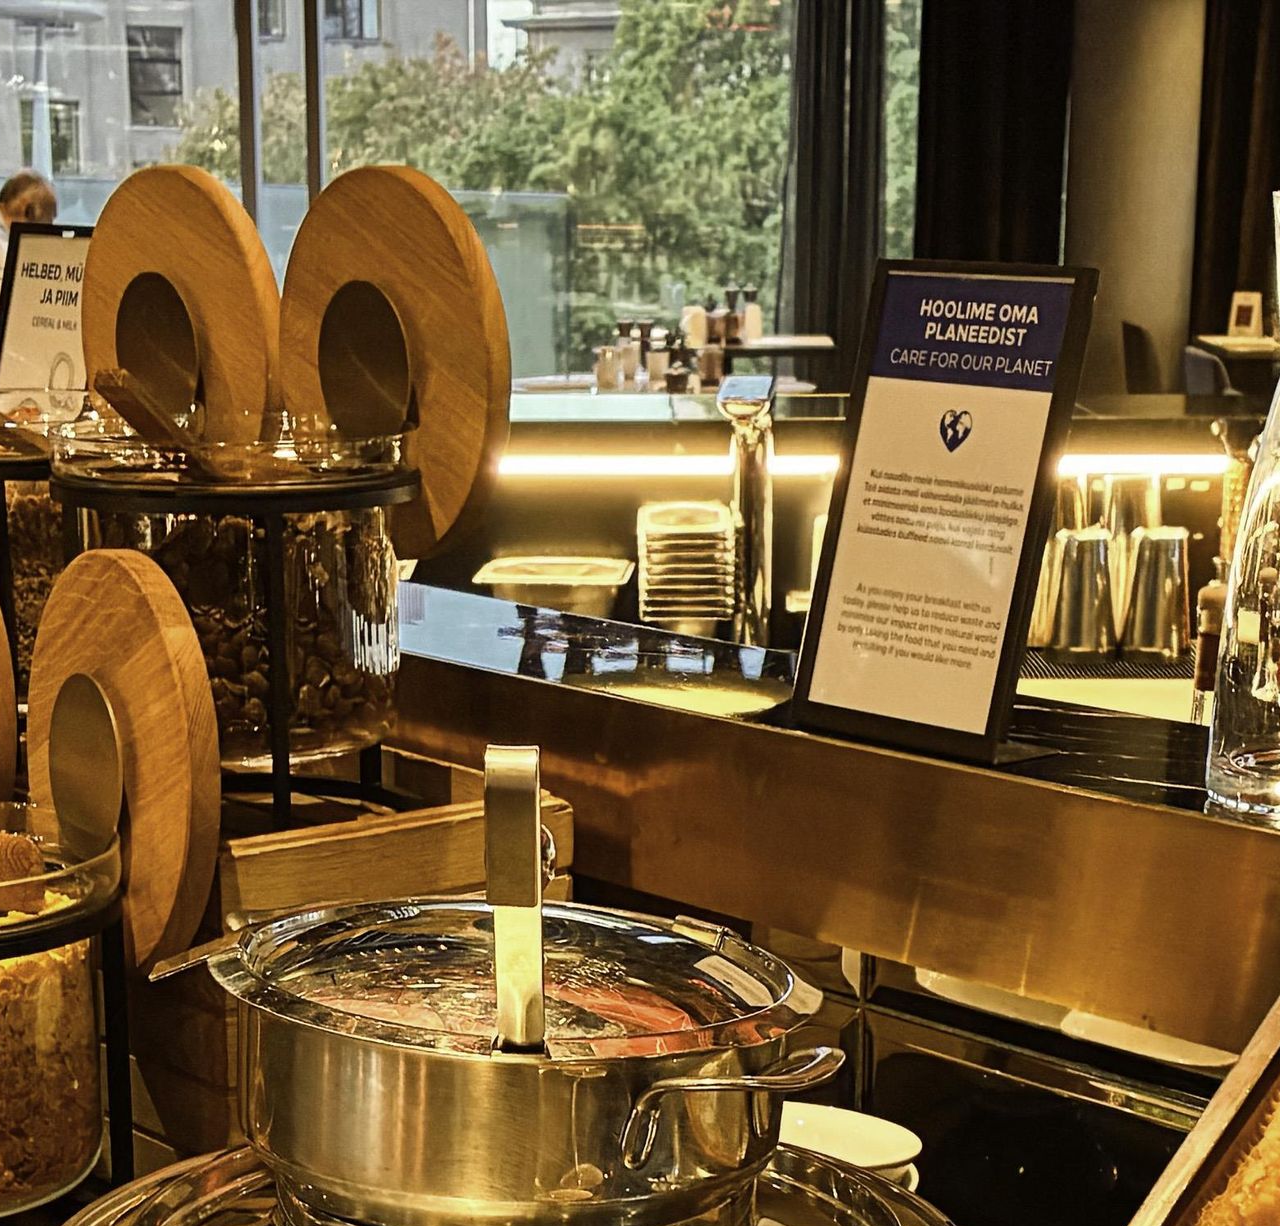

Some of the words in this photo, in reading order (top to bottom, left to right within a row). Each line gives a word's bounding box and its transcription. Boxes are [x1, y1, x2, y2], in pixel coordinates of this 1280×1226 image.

[40, 288, 52, 304] JA
[55, 289, 78, 307] PIIM
[920, 299, 996, 321] HOOLIME
[998, 303, 1039, 325] OMA
[924, 321, 1027, 347] PLANEEDIST
[890, 348, 928, 366] CARE
[929, 351, 959, 369] FOR
[960, 354, 993, 371] OUR
[994, 356, 1053, 377] PLANET
